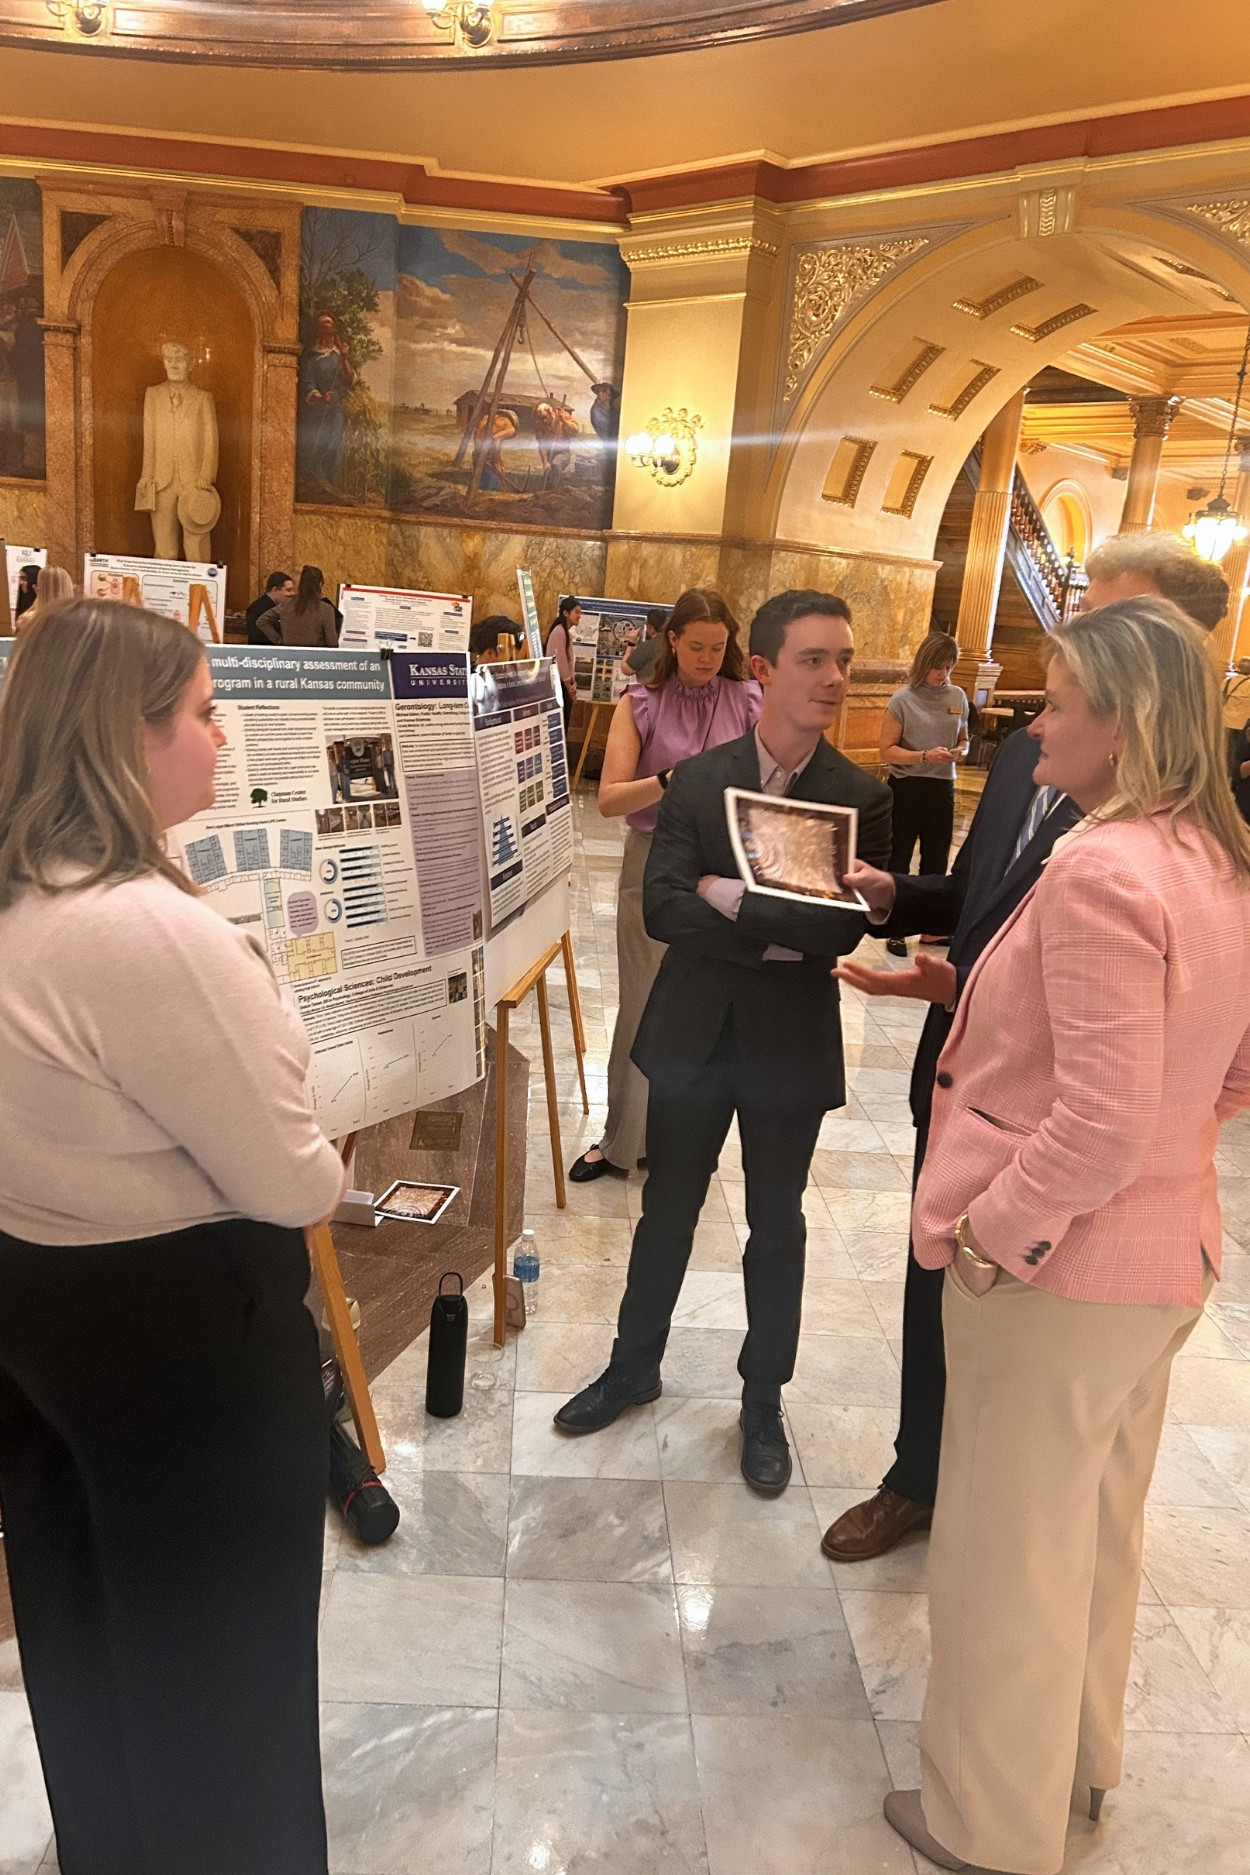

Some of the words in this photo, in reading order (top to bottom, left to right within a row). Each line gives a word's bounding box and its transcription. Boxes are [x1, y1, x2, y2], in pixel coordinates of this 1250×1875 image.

[212, 656, 300, 671] multi-disciplinary
[303, 660, 357, 671] assessment
[359, 660, 368, 671] of
[370, 662, 380, 671] an
[409, 664, 447, 676] KANSAS
[213, 679, 251, 691] rogram
[253, 677, 264, 688] in
[267, 680, 272, 689] a
[276, 678, 298, 689] rural
[301, 678, 334, 690] Kansas
[336, 679, 385, 692] community
[298, 986, 342, 1003] Psychological
[344, 979, 375, 991] Sciences:
[376, 974, 392, 984] Child
[393, 966, 432, 980] Development
